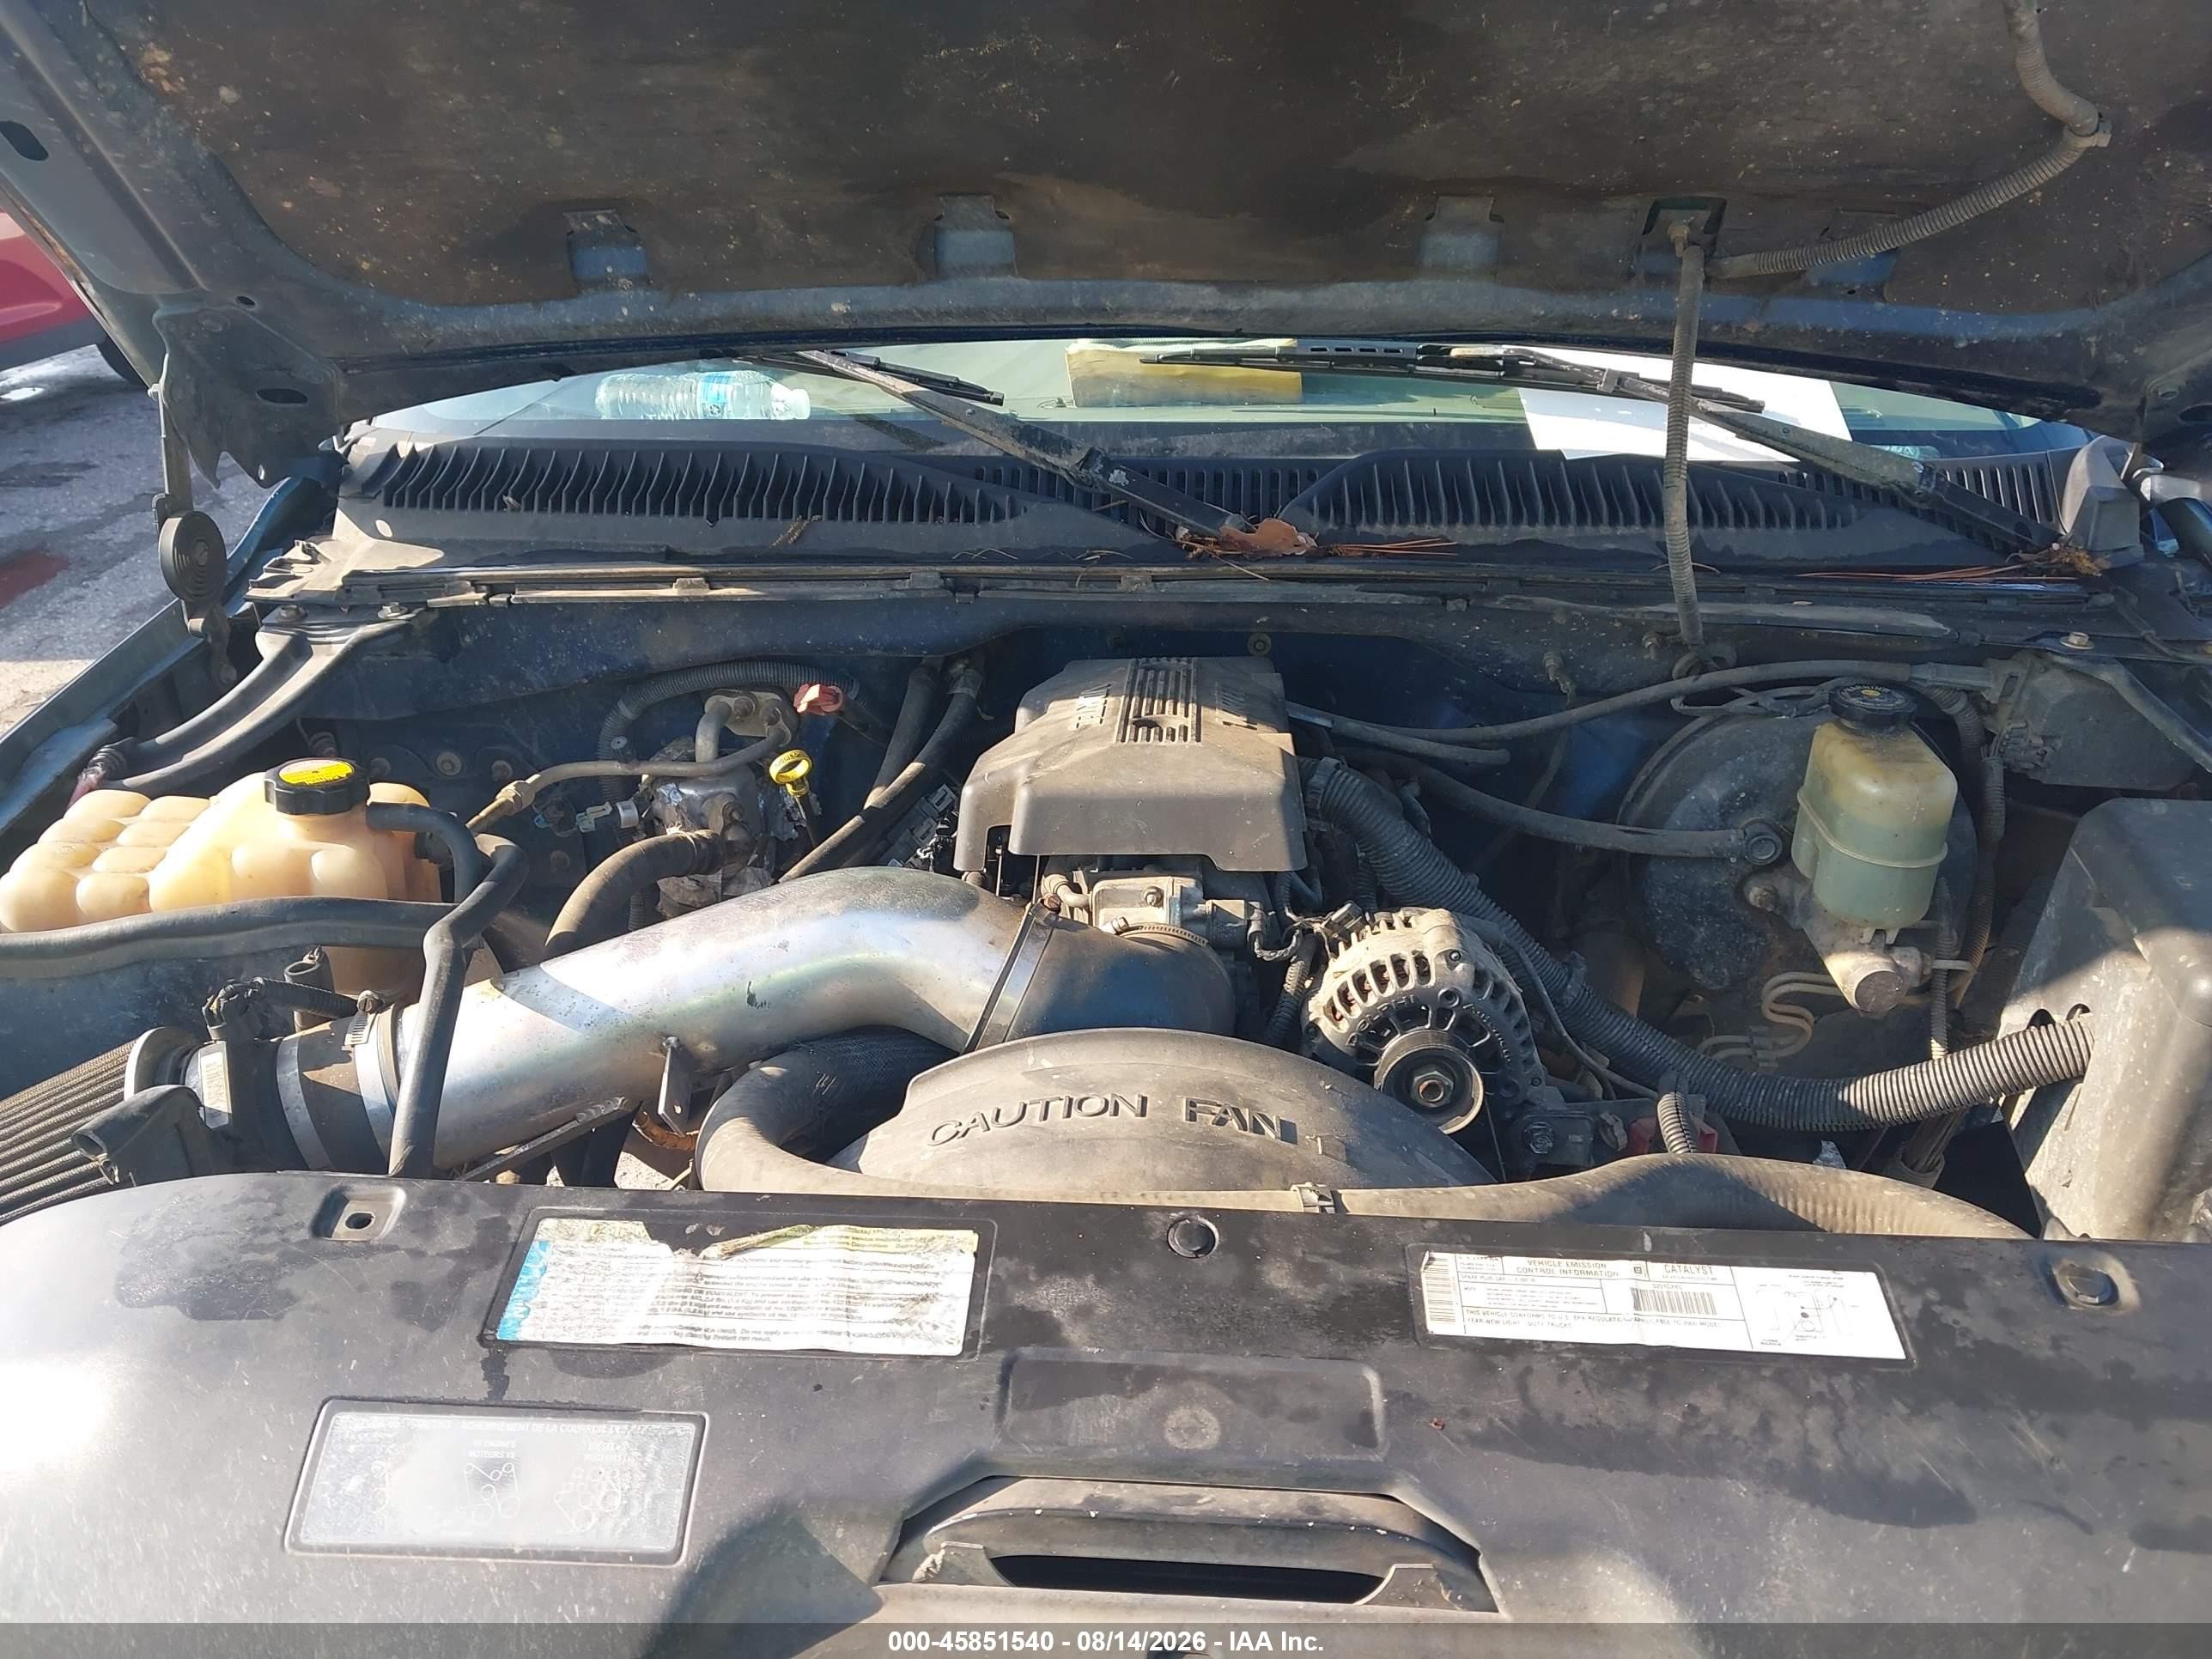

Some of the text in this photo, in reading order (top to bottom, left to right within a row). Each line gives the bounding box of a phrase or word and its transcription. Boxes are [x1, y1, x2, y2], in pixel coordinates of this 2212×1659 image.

[927, 1093, 1297, 1146] CAUTION FAN
[1527, 1259, 1607, 1269] VEHICLE EMISSION
[1663, 1264, 1713, 1275] CATALYST
[1516, 1266, 1619, 1278] CONTROL INFORMATION
